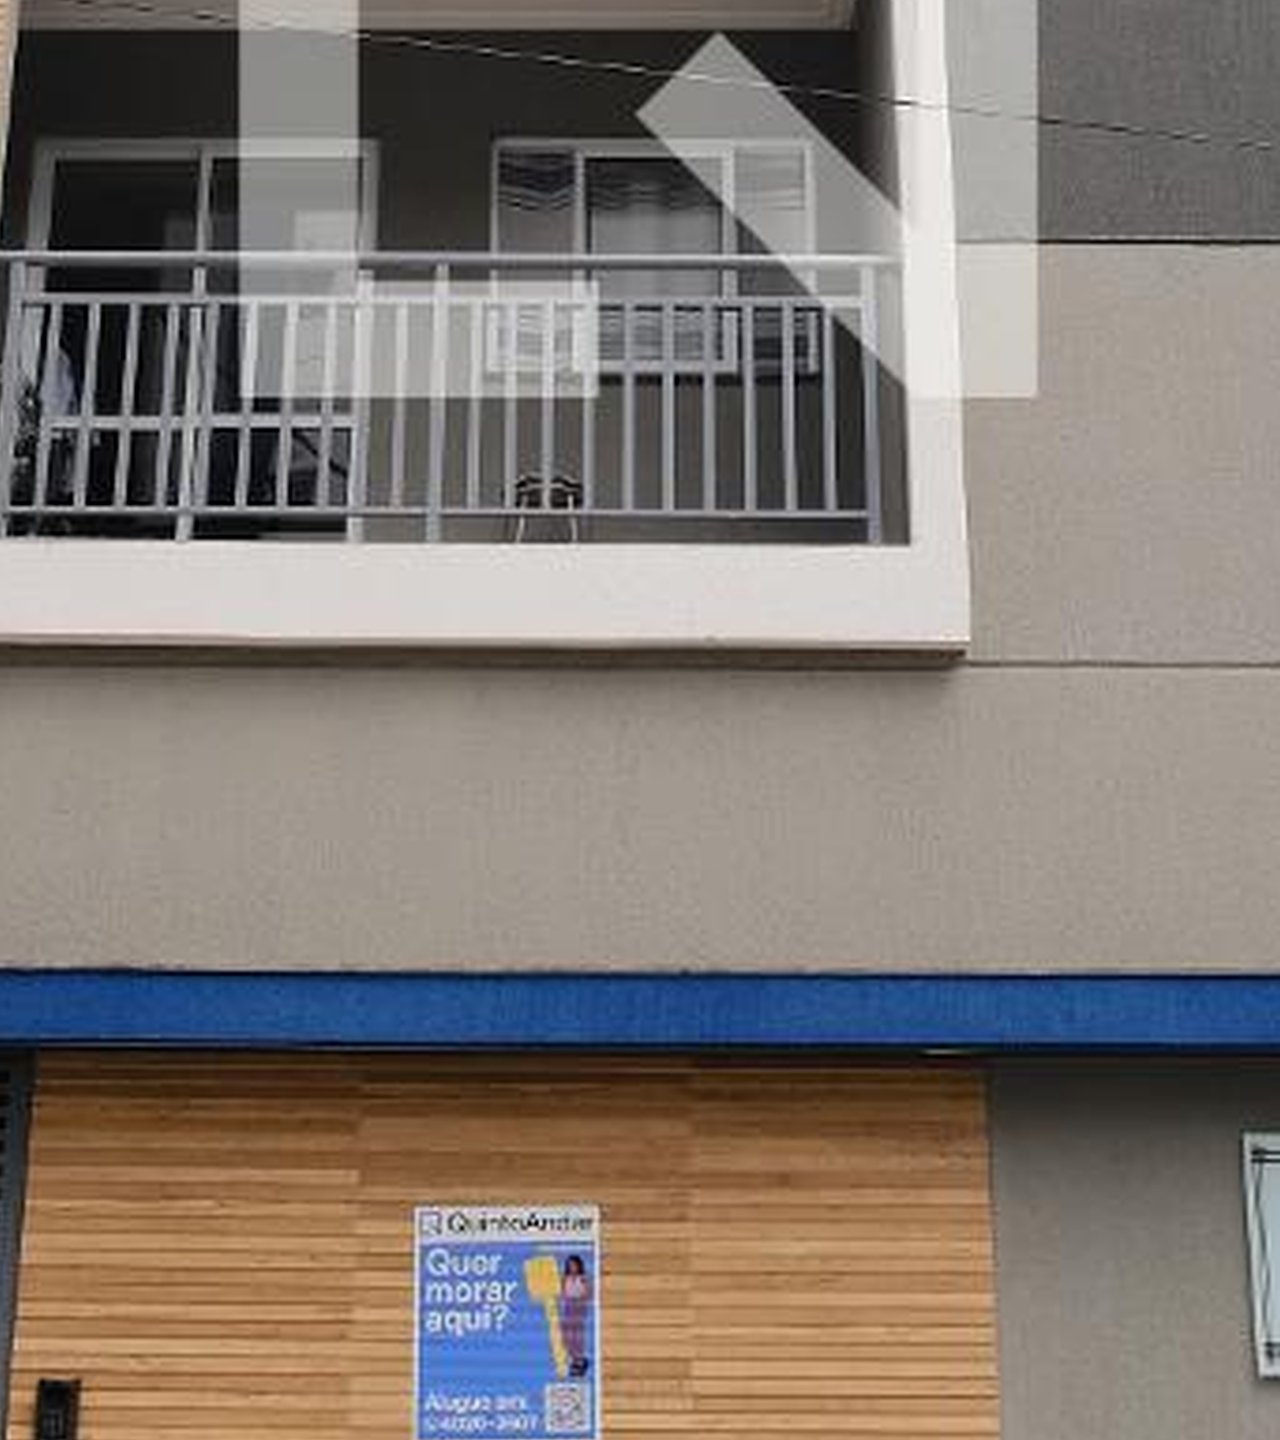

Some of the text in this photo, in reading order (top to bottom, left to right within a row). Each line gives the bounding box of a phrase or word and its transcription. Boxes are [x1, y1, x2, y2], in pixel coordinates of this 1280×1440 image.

[426, 1248, 503, 1276] Quer
[425, 1281, 518, 1303] morar
[425, 1305, 510, 1337] aqui?
